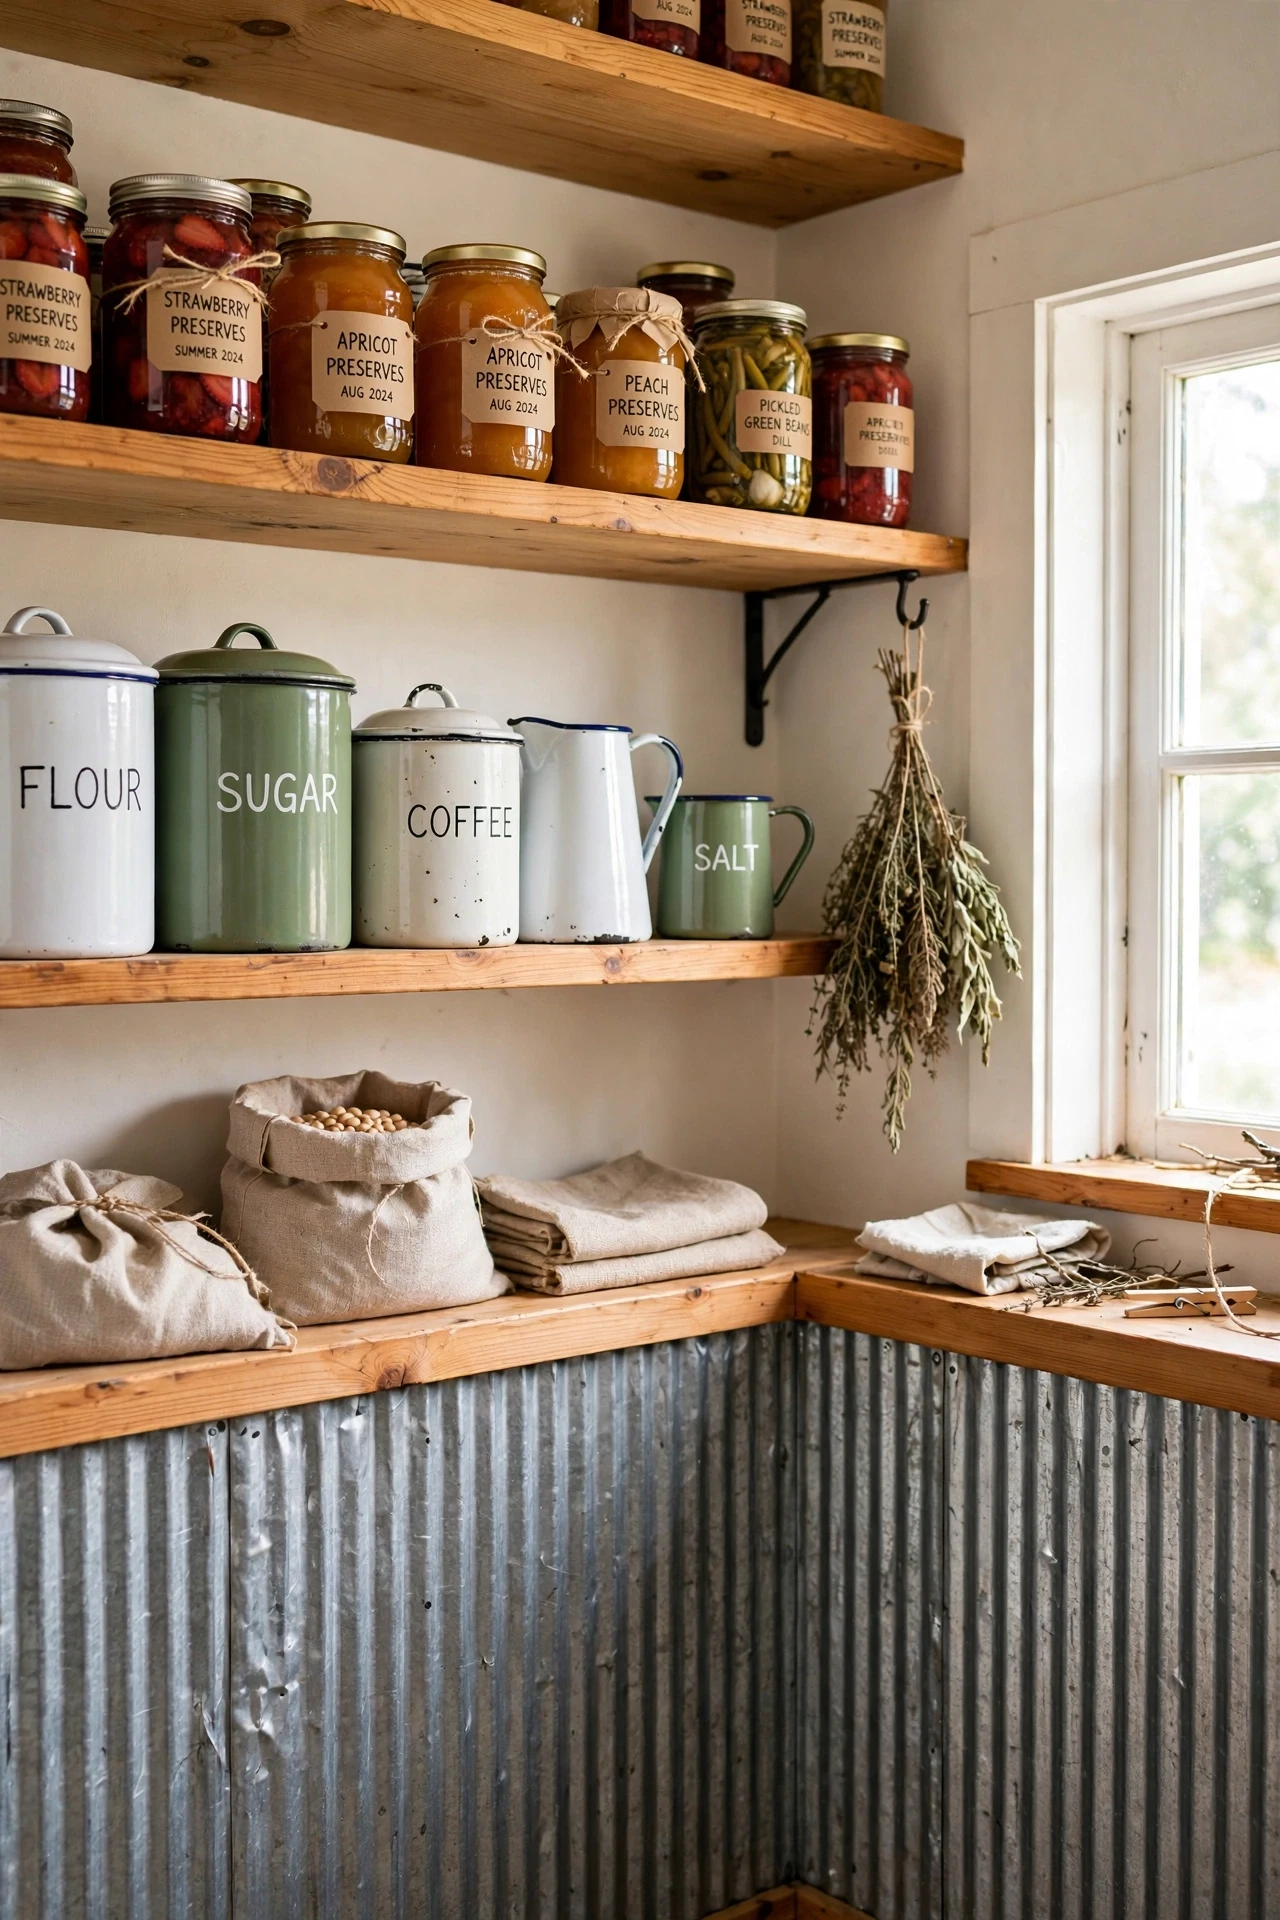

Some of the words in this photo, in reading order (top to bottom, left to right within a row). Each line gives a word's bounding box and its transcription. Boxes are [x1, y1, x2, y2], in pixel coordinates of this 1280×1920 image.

[656, 0, 673, 12] AUG
[832, 28, 882, 50] PRESERVES
[0, 278, 82, 308] STRAWBERRY
[164, 290, 250, 320] STRAWBERRY
[6, 304, 78, 332] PRESERVES
[171, 316, 246, 343] PRESERVES
[8, 331, 51, 348] SUMMER
[54, 338, 75, 352] 2024
[337, 331, 397, 356] APRICOT
[175, 344, 218, 360] SUMMER
[221, 350, 244, 364] 2024
[486, 346, 542, 371] APRICOT
[326, 357, 404, 384] PRESERVES
[340, 385, 364, 399] AUG
[369, 387, 393, 403] 2024
[476, 372, 547, 397] PRESERVES
[625, 374, 669, 396] PEACH
[489, 398, 512, 411] AUG
[516, 402, 538, 415] 2024
[608, 399, 679, 422] PRESERVES
[760, 399, 800, 416] PICKLED
[622, 424, 645, 437] AUG
[648, 426, 670, 440] 2024
[744, 416, 781, 430] GREEN
[785, 418, 810, 436] BEANS
[772, 434, 792, 448] DILL
[20, 765, 142, 812] FLOUR
[216, 771, 339, 815] SUGAR
[407, 804, 513, 839] COFFEE
[693, 843, 760, 873] SALT
